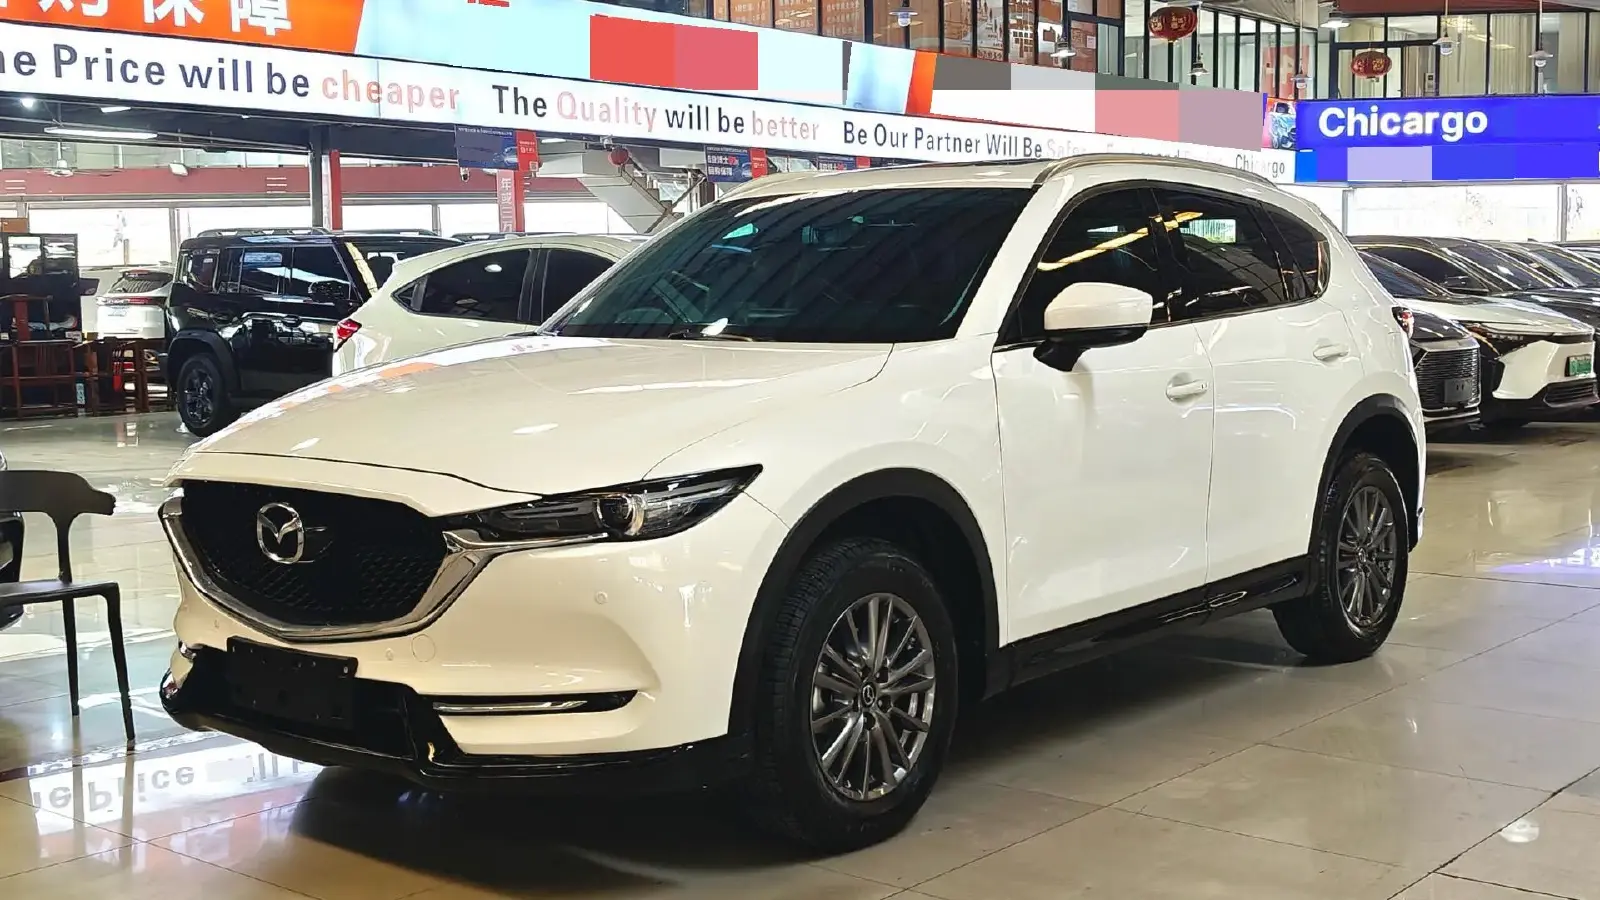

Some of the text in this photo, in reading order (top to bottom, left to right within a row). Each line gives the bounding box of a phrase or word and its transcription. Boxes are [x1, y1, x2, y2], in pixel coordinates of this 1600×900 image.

[53, 43, 165, 85] Price
[179, 57, 253, 93] will
[266, 62, 309, 97] be
[322, 69, 459, 113] cheaper
[492, 85, 819, 140] The Quality will be better
[1318, 105, 1488, 142] Chicargo
[844, 121, 867, 145] Be
[874, 123, 908, 148] Our
[914, 127, 980, 153] Partner
[986, 133, 1018, 157] Will
[1023, 137, 1042, 158] Be
